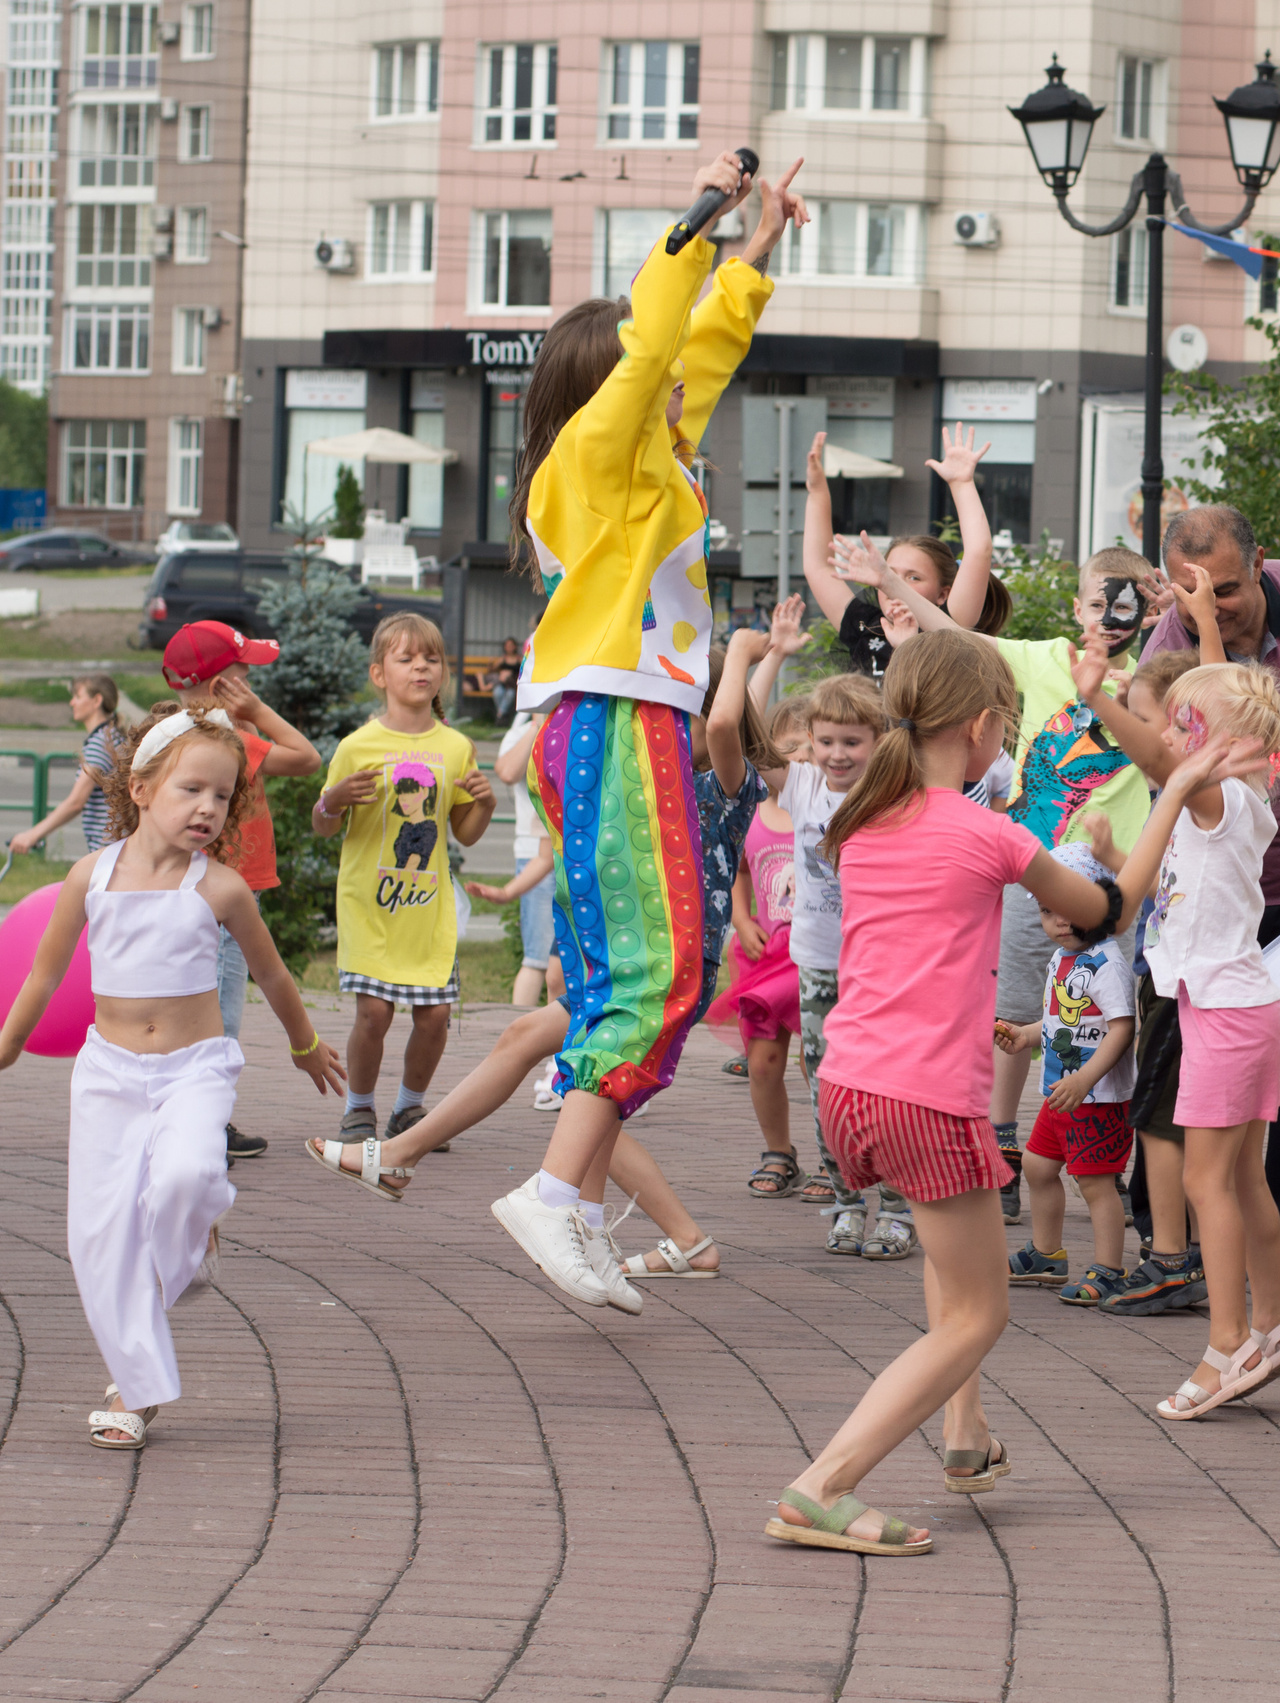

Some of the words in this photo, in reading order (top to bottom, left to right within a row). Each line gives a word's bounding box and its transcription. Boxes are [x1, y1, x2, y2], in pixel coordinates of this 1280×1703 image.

[465, 332, 545, 365] TomY
[383, 750, 445, 764] GLAMOUR
[378, 869, 438, 885] DIVA
[376, 876, 438, 914] Chic
